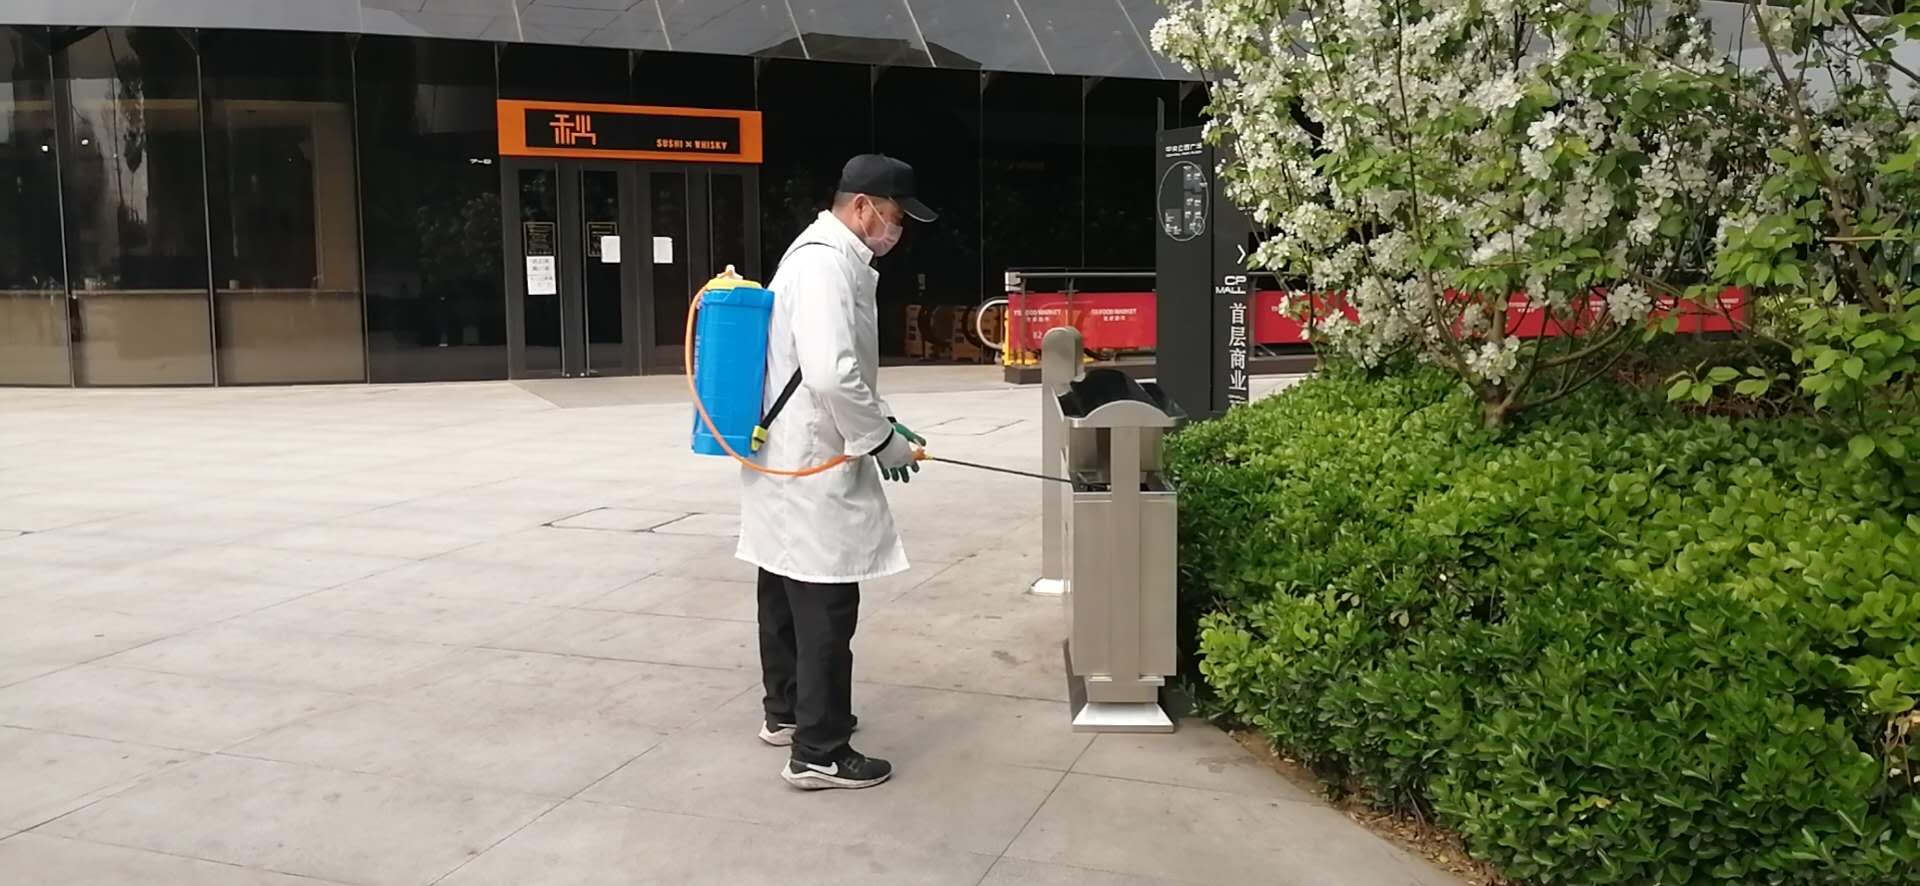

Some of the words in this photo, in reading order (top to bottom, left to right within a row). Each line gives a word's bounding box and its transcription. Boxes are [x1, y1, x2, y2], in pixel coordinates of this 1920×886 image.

[656, 138, 683, 148] SUSHI
[694, 140, 728, 151] WHISKY
[1224, 275, 1247, 286] CP
[1215, 286, 1247, 295] MALL
